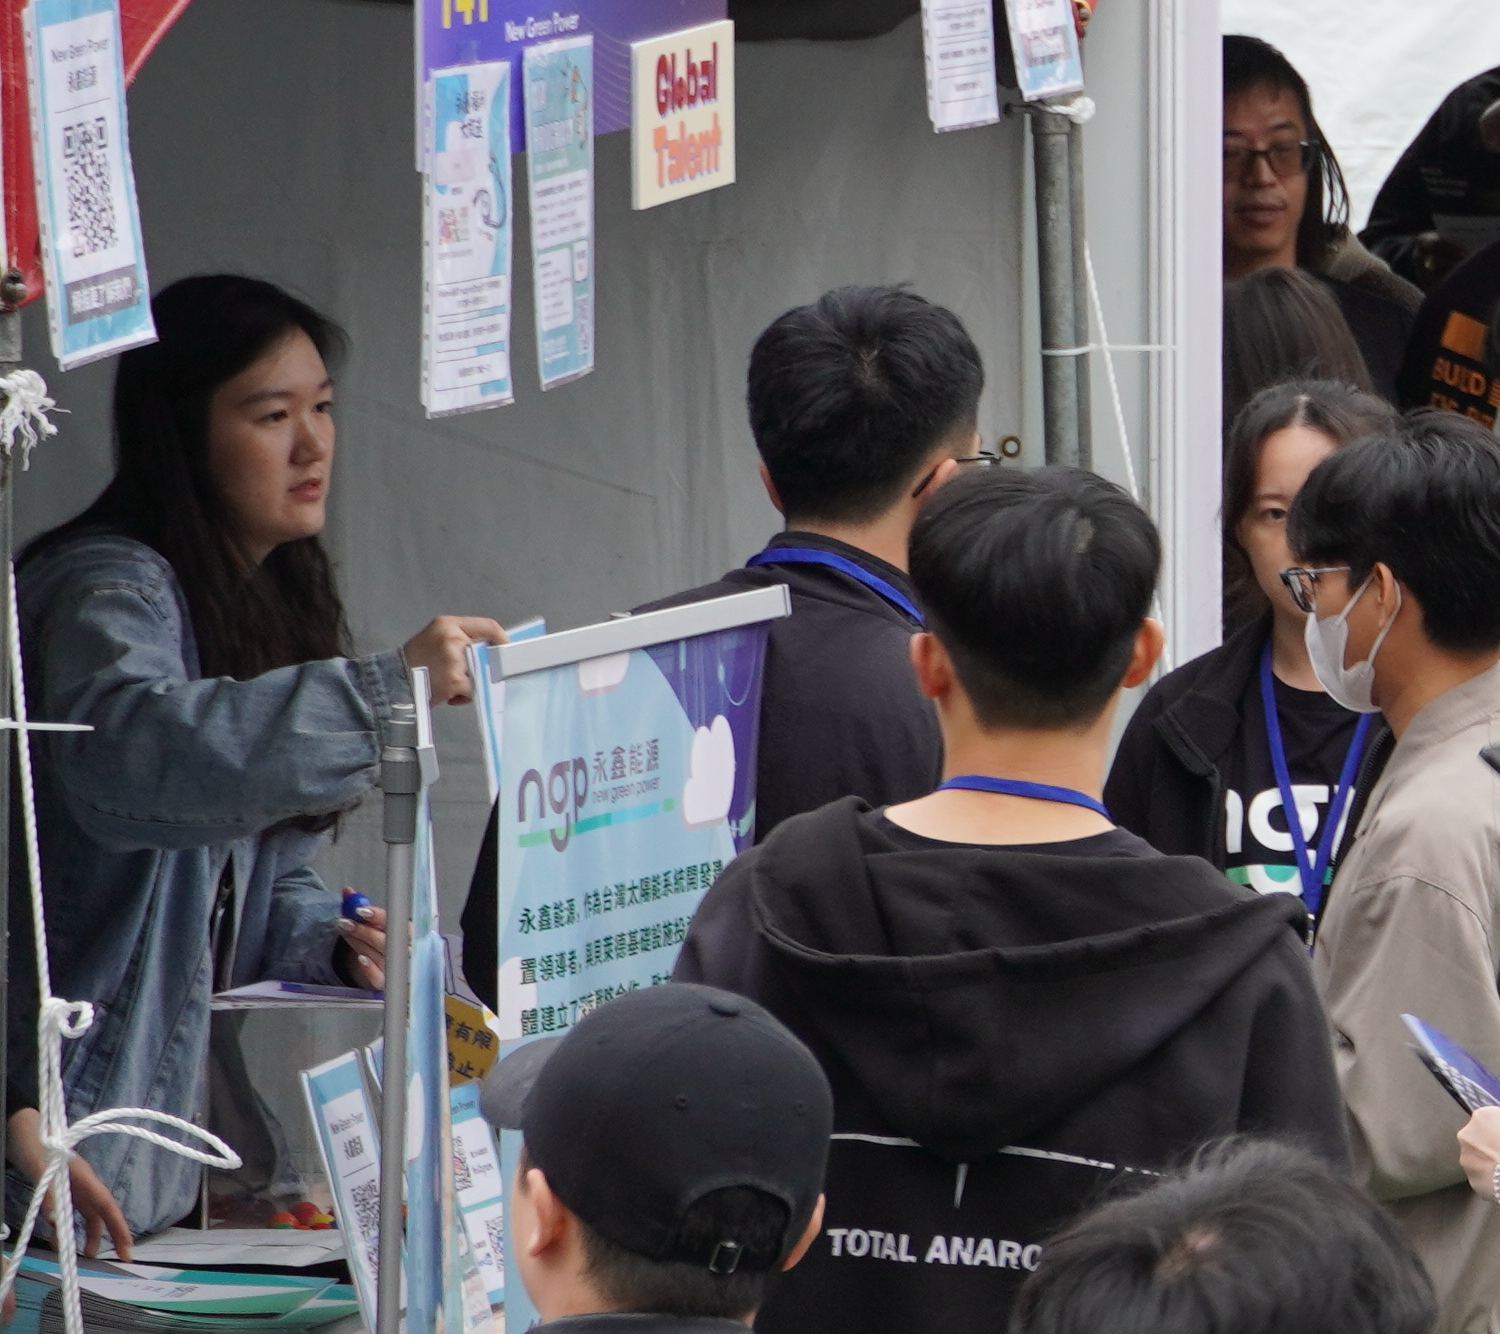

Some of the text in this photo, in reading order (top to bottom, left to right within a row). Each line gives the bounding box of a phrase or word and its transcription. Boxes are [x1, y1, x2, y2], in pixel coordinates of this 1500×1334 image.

[504, 12, 580, 43] New Green Power
[655, 42, 718, 119] Global
[653, 111, 721, 188] Talent
[592, 738, 661, 785] 永鑫能源
[518, 756, 589, 853] ngp
[593, 776, 661, 805] new green power
[826, 1228, 917, 1263] TOTAL
